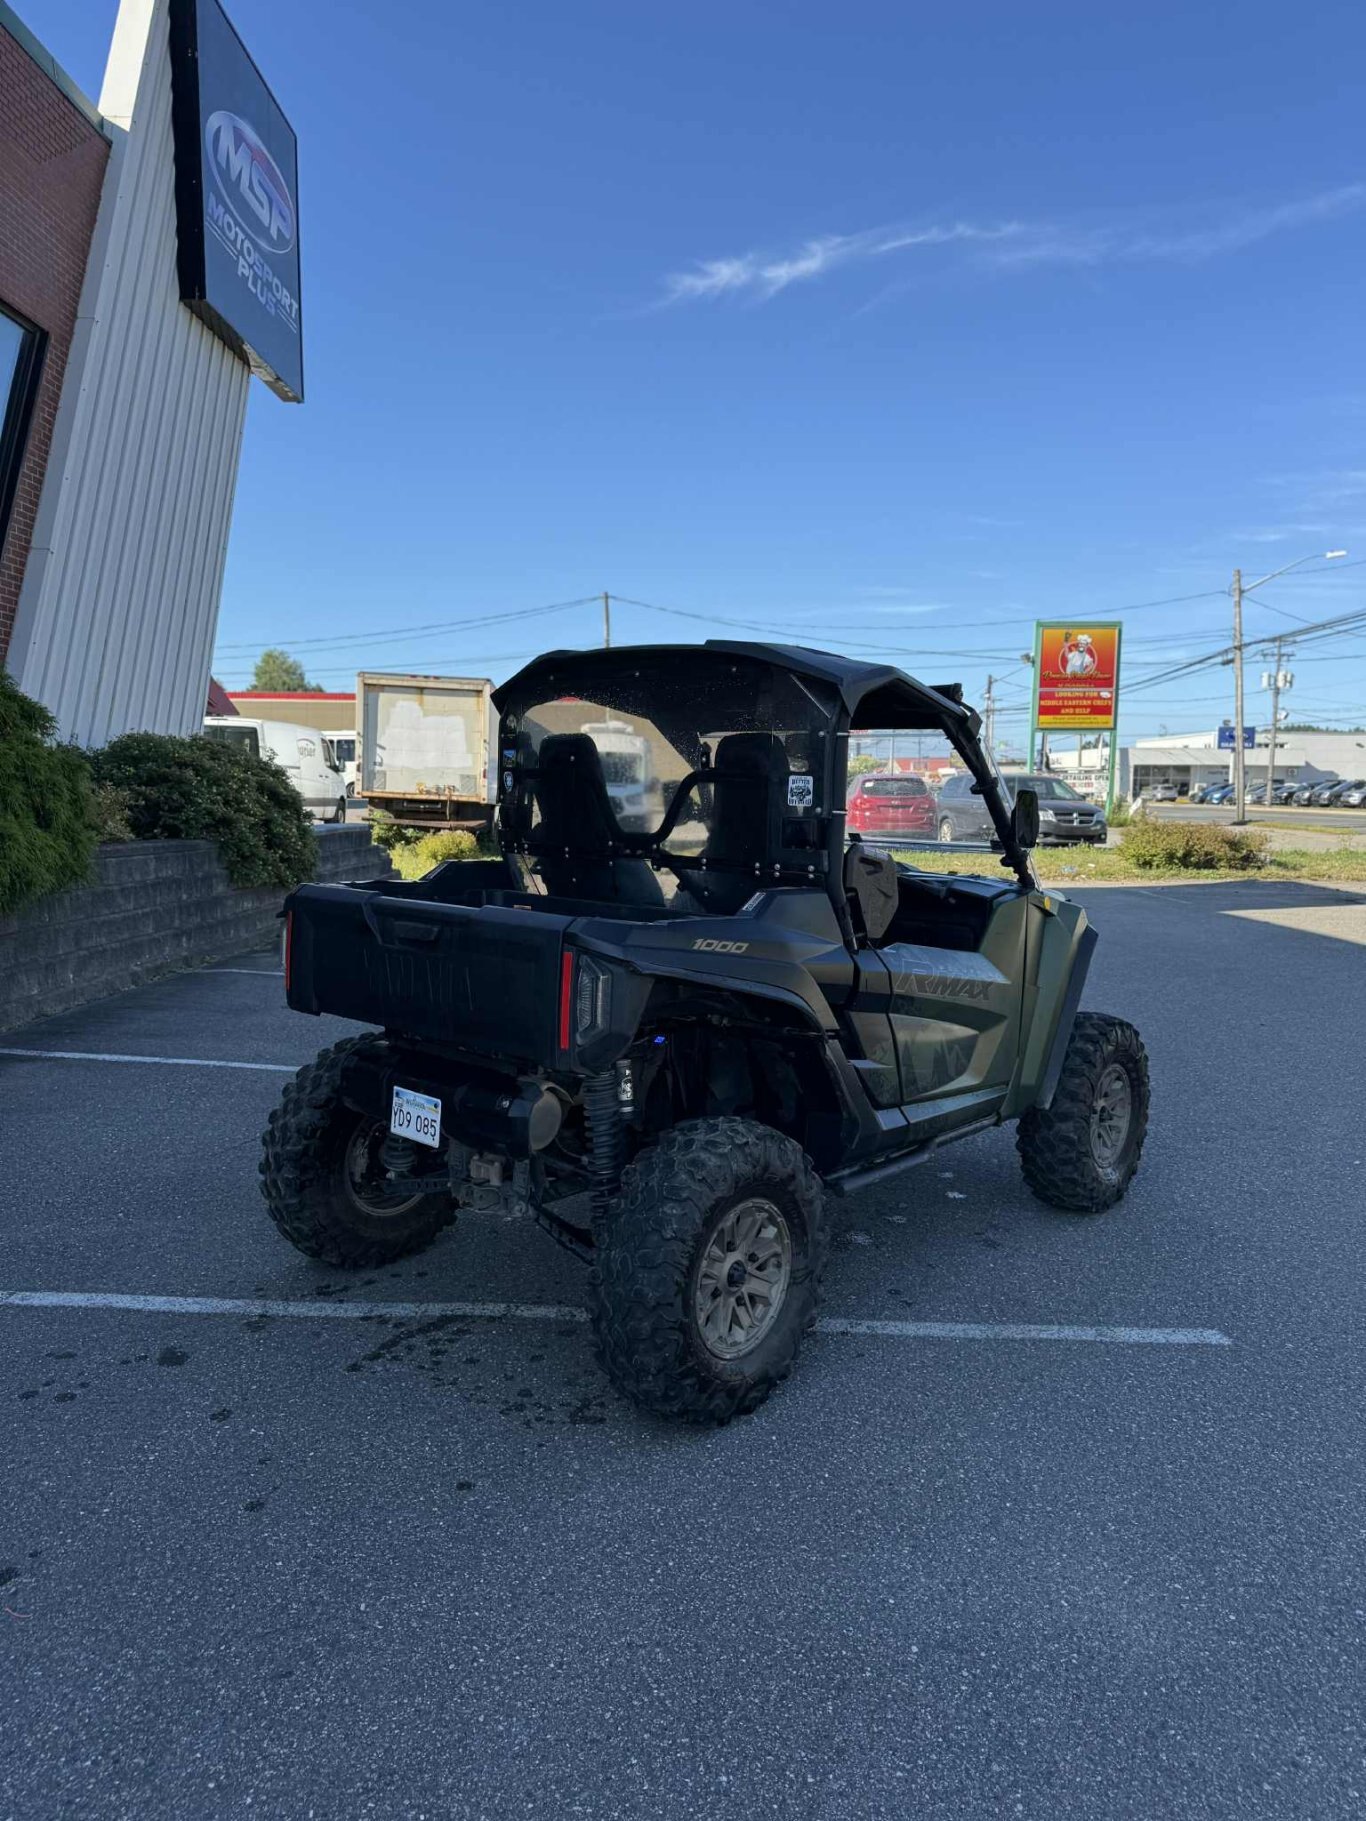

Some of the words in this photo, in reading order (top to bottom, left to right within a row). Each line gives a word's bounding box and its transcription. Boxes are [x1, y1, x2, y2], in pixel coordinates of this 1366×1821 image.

[216, 124, 292, 242] MSP
[207, 191, 299, 319] MOTOSPORT
[236, 255, 276, 316] PLUS
[692, 938, 750, 954] 1000
[393, 1106, 412, 1128] YD9
[415, 1115, 437, 1137] 085
